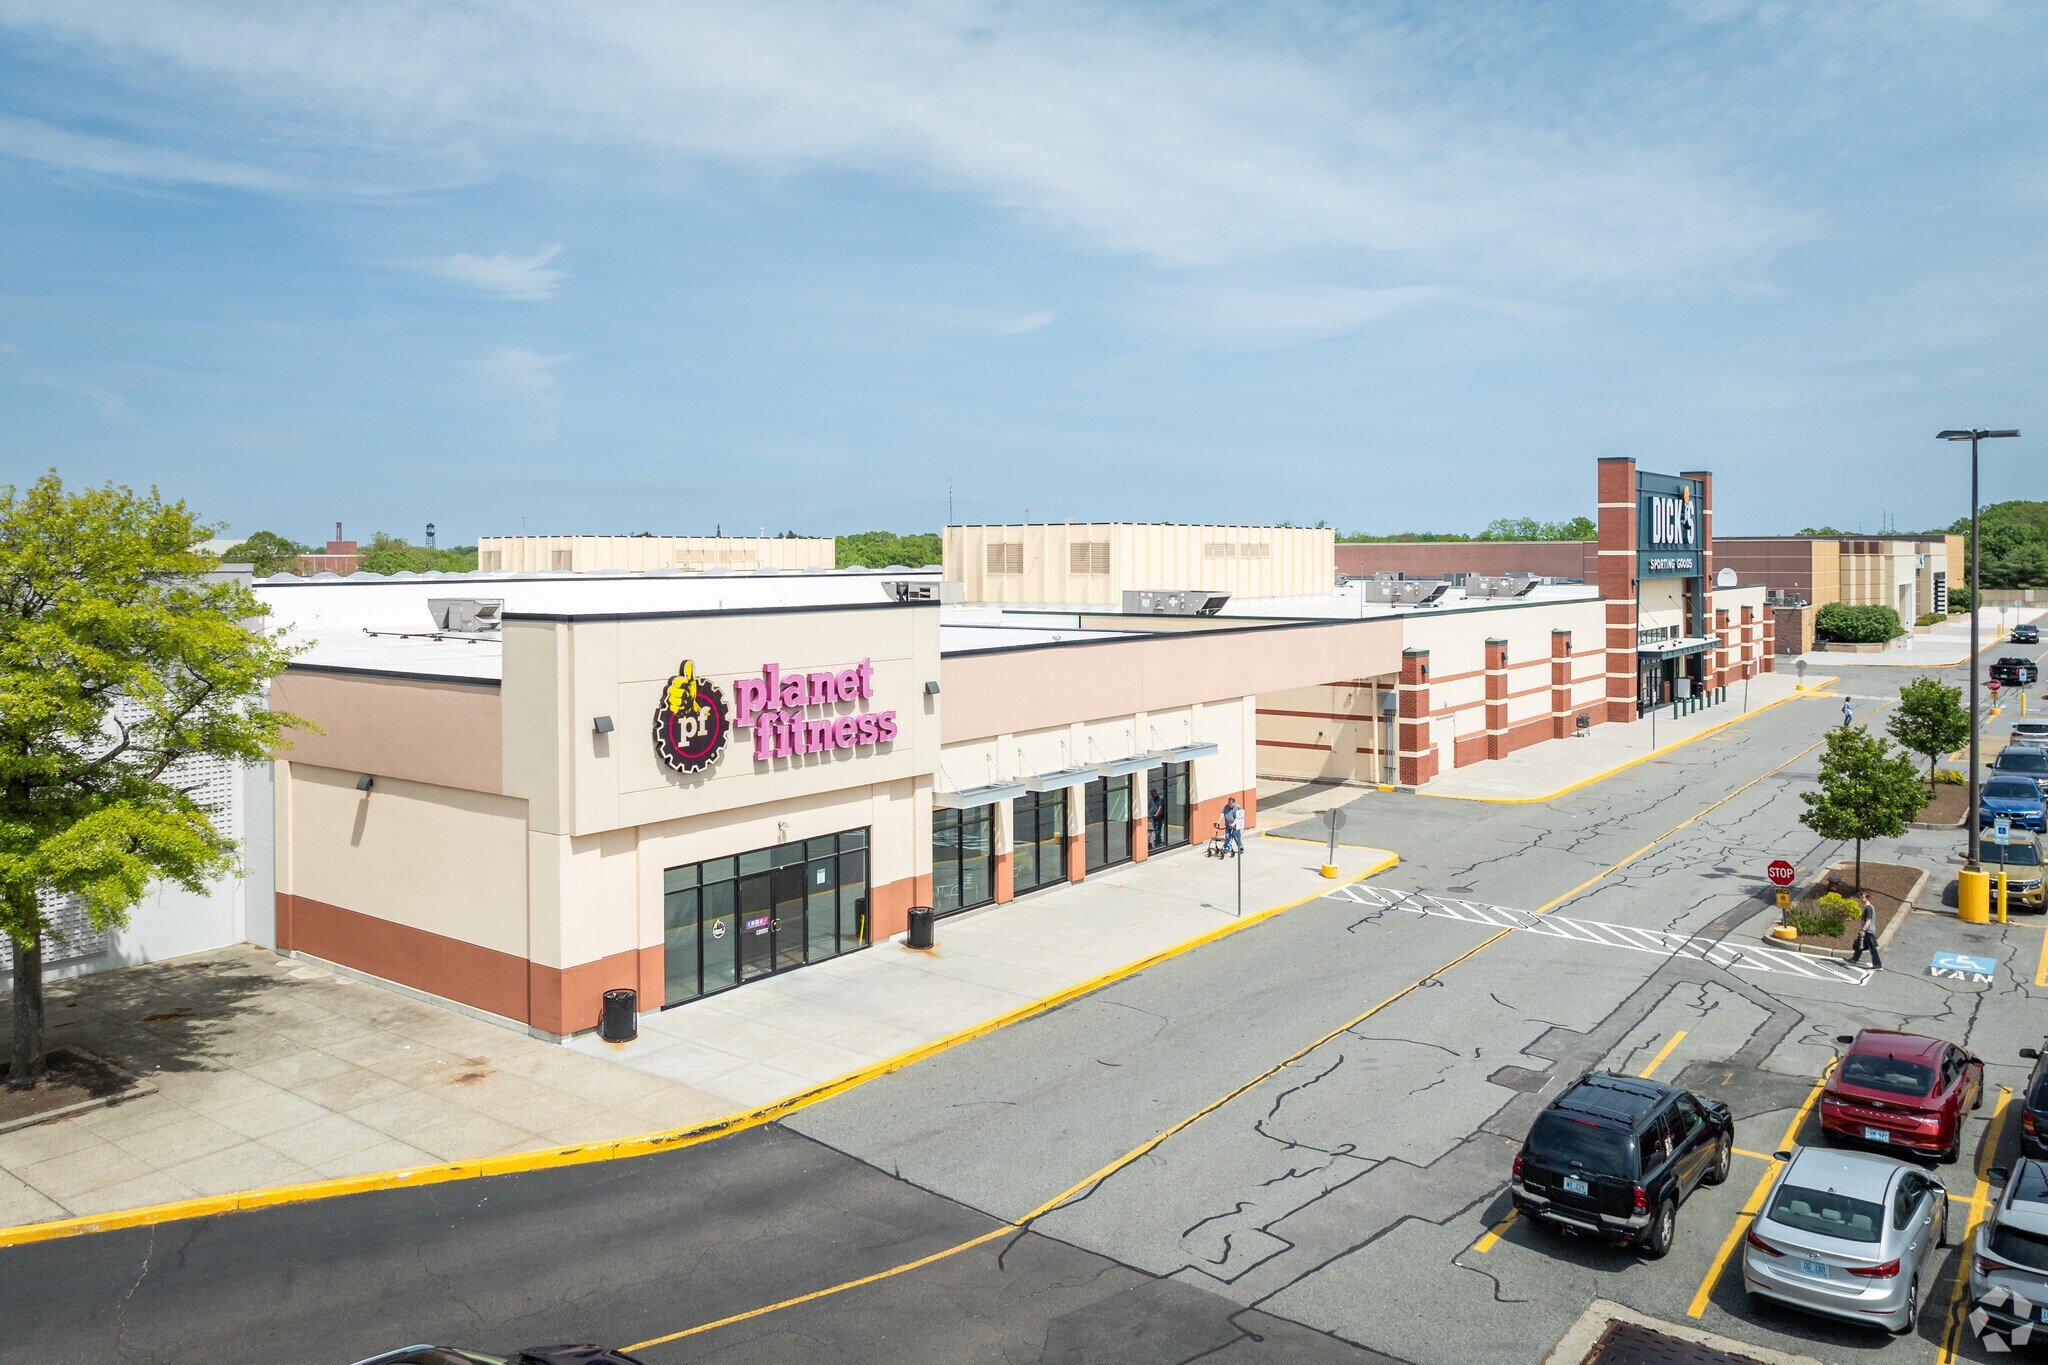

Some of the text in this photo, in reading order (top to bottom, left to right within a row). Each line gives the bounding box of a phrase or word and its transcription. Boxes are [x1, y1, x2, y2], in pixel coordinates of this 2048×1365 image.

[1650, 558, 1693, 570] SPORTING GOODS
[733, 657, 874, 727] planet
[678, 706, 711, 748] pf
[753, 710, 898, 760] fitness
[1769, 867, 1794, 879] STOP
[1930, 966, 1994, 984] VAN
